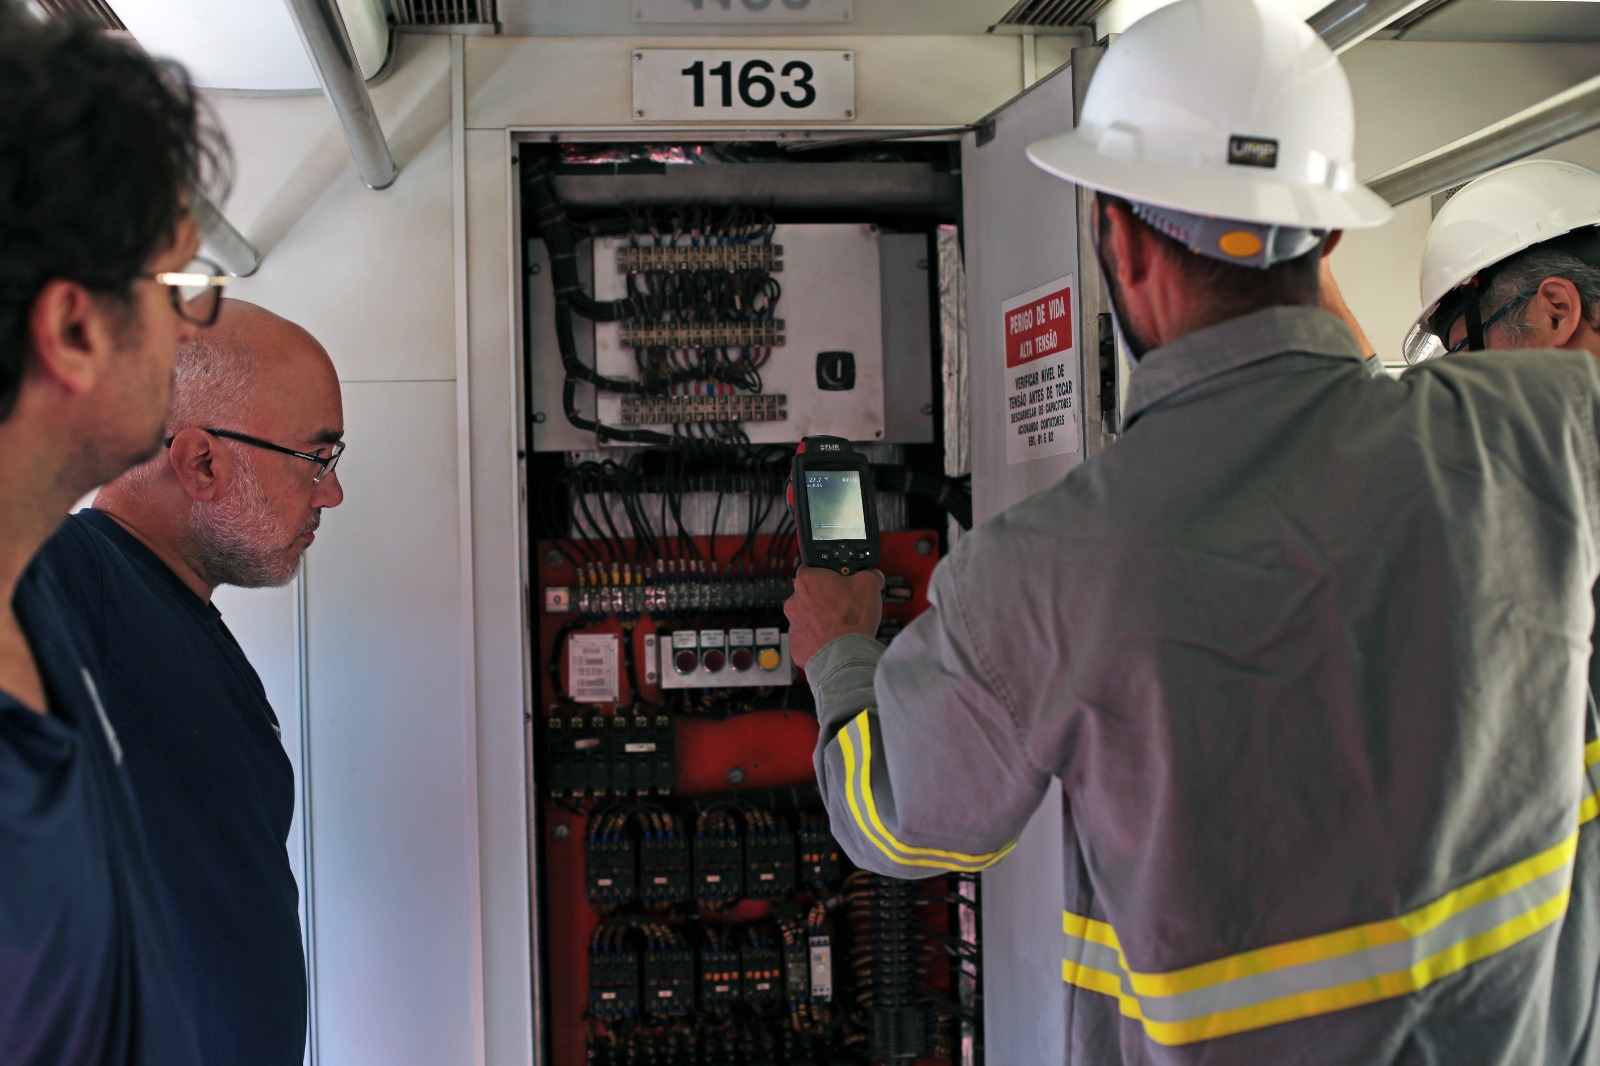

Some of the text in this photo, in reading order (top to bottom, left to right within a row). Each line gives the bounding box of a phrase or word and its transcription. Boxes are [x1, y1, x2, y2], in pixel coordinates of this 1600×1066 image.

[681, 59, 816, 108] 1163
[1010, 296, 1066, 335] PERIGO DE VIDA
[1019, 328, 1058, 359] ALTA TENSÃO
[1015, 363, 1065, 390] VERIFICAR NÍVEL DE
[1008, 380, 1073, 410] TENSÃO ANTES DE TOCAR
[1038, 404, 1044, 416] OS
[1018, 414, 1065, 435] ACIONANDO CONTATORES
[1043, 432, 1047, 444] E
[1048, 431, 1054, 443] B2
